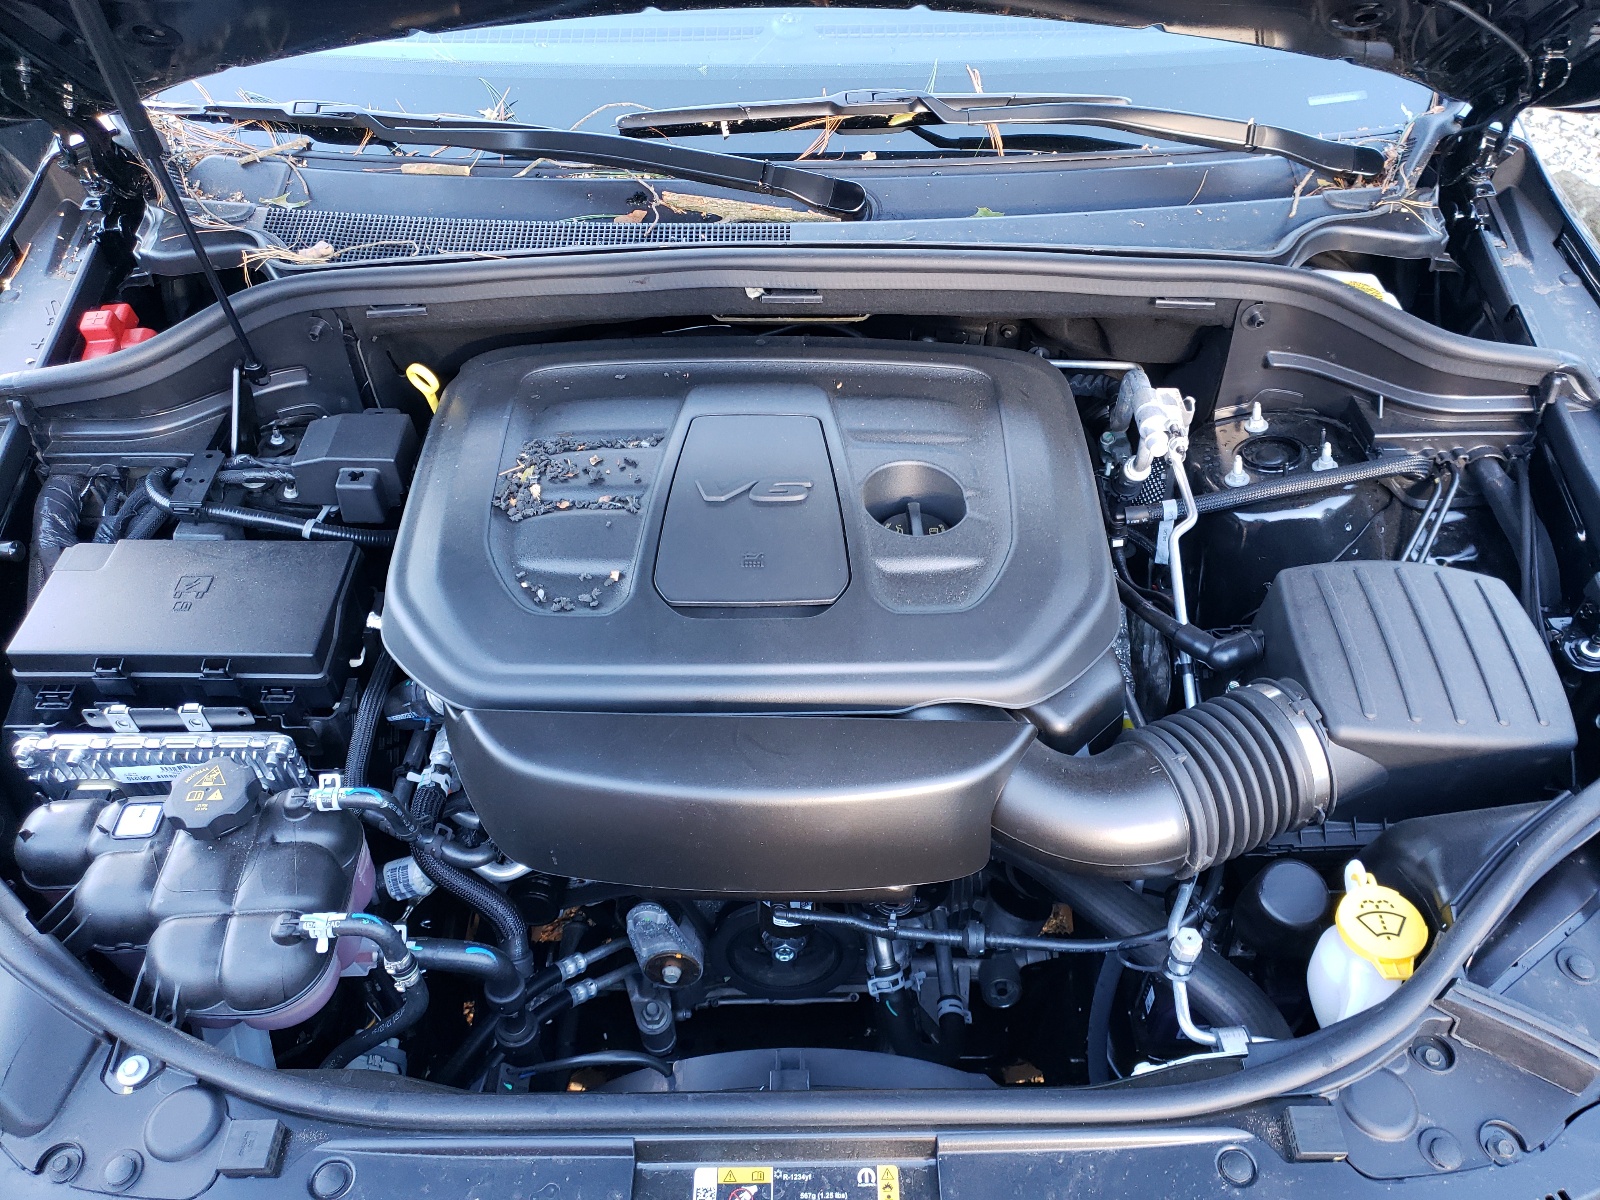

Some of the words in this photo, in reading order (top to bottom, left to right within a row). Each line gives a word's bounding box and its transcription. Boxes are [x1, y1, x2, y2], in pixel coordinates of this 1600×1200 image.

[694, 479, 814, 502] V6
[782, 1173, 812, 1182] R-1234yf
[799, 1191, 816, 1200] 567g
